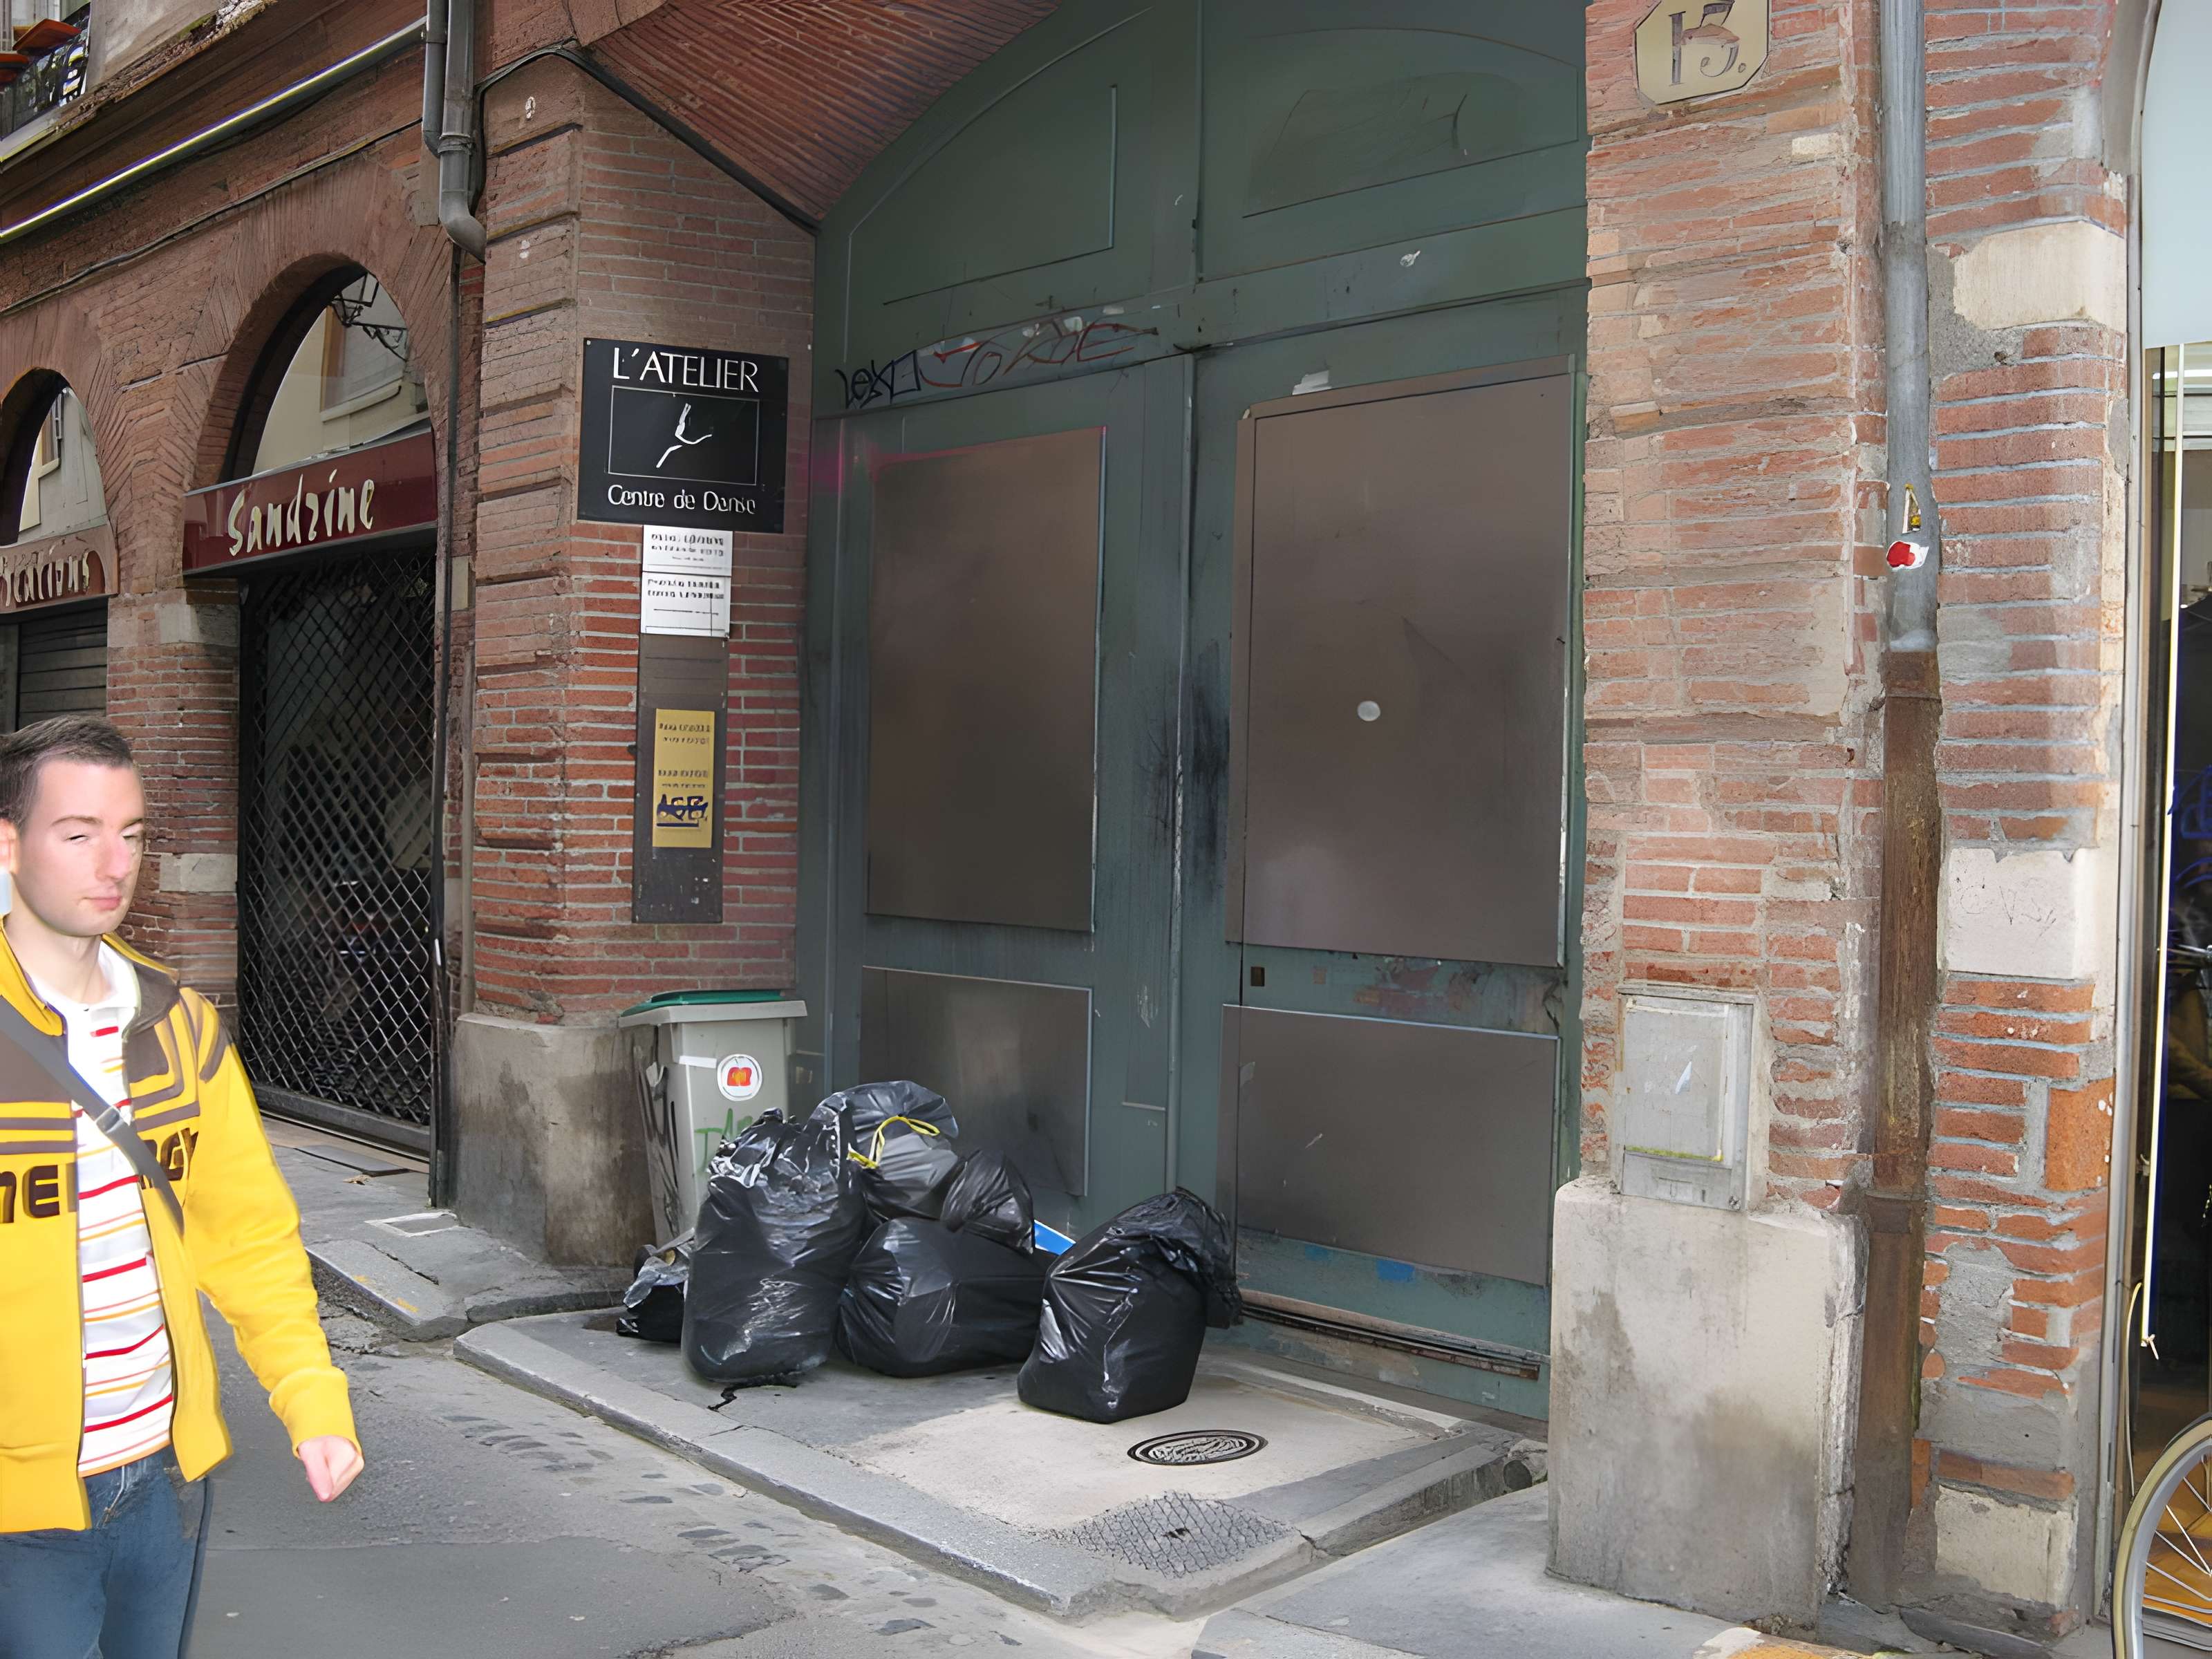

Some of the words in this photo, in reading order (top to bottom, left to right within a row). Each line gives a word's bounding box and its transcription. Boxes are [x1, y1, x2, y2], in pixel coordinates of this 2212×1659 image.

[613, 347, 760, 393] L'ATELIER
[227, 469, 375, 556] Sandrine
[608, 484, 665, 508] Centre
[673, 482, 695, 510] de
